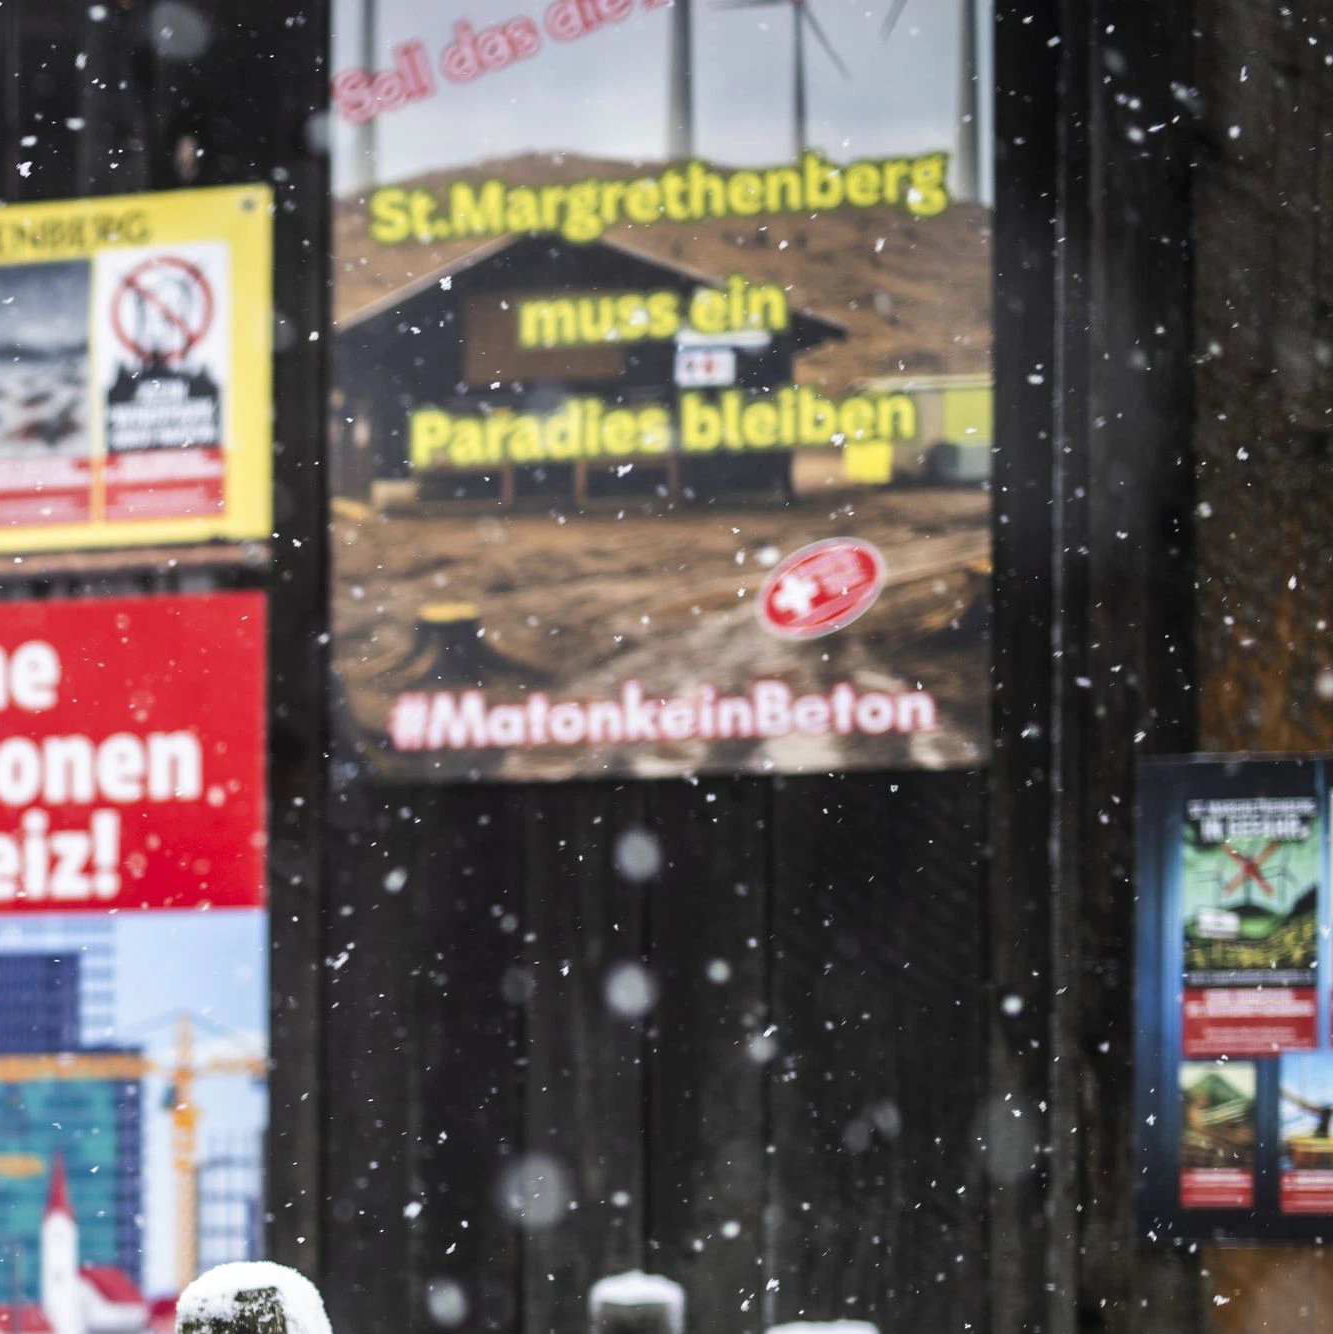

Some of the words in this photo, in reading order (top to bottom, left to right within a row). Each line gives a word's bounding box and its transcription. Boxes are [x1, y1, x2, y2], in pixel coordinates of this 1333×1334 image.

[440, 18, 540, 84] das
[369, 149, 950, 245] St.Margrethenberg
[518, 291, 679, 349] muss
[688, 276, 788, 332] ein
[409, 398, 674, 468] Paradies
[681, 385, 917, 452] bleiben
[390, 680, 936, 751] #MatonkeinBeton
